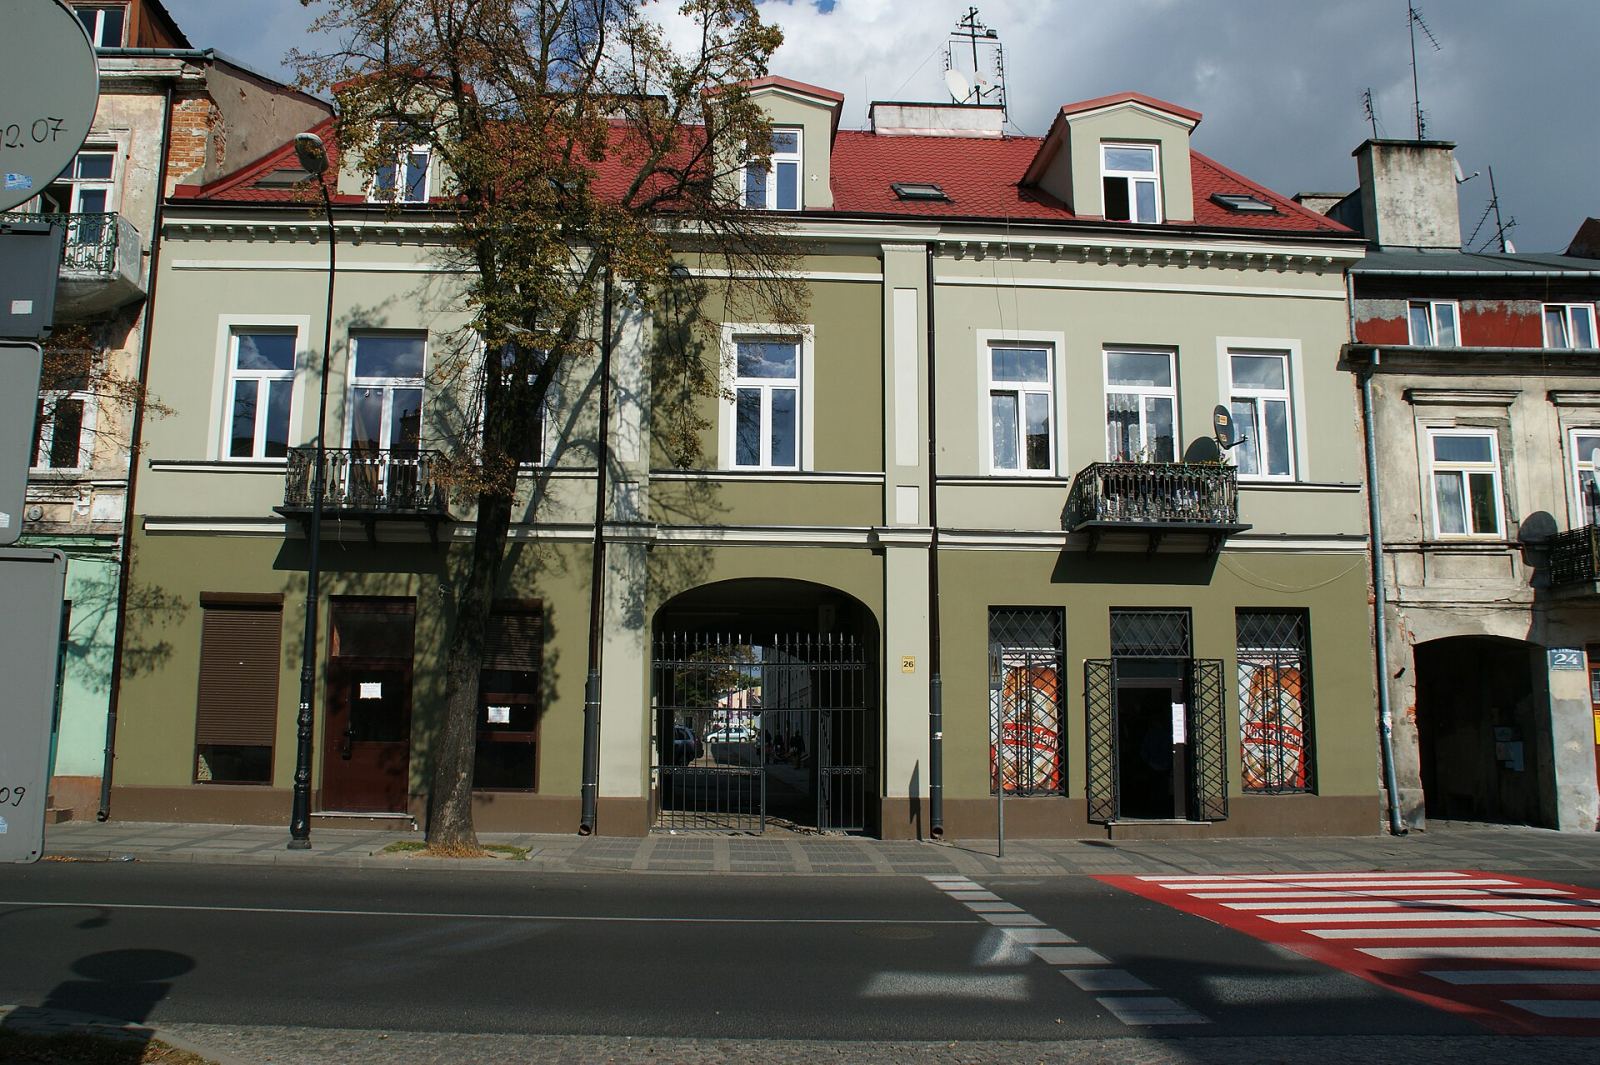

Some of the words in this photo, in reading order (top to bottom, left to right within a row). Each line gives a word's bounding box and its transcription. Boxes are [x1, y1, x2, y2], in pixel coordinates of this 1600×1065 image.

[903, 660, 914, 668] 26
[1554, 653, 1578, 665] 24
[0, 786, 26, 807] 09
